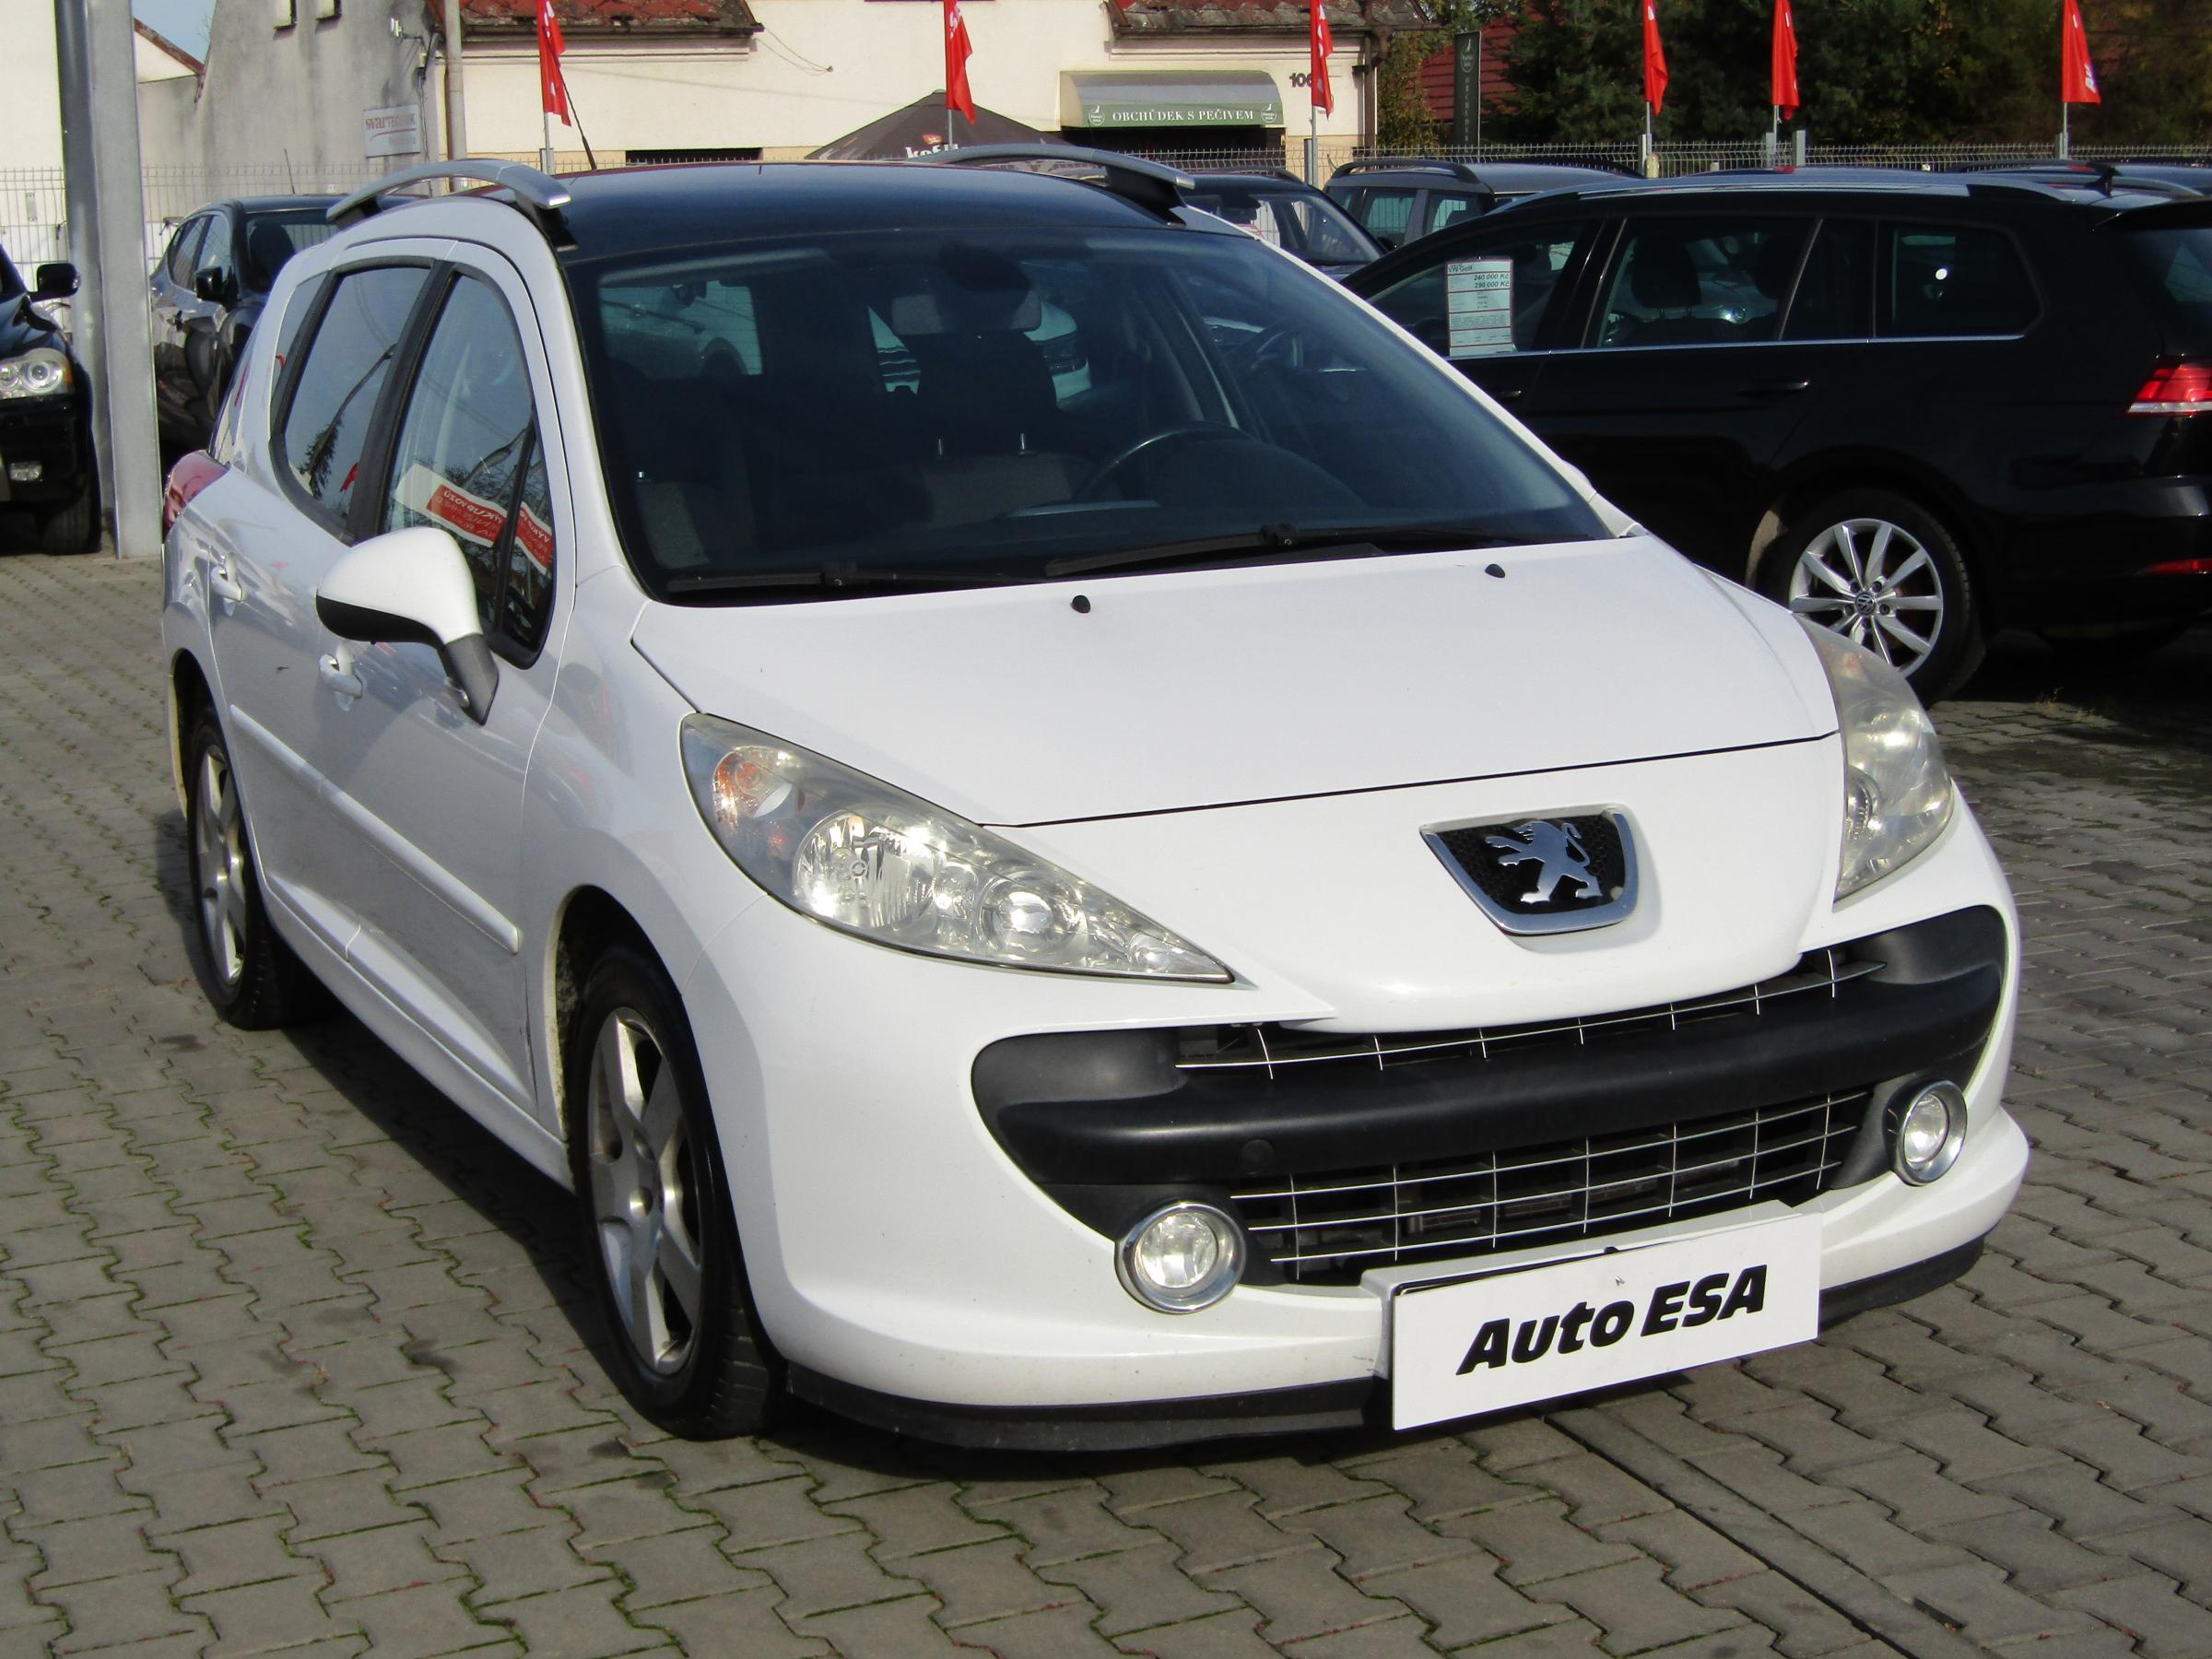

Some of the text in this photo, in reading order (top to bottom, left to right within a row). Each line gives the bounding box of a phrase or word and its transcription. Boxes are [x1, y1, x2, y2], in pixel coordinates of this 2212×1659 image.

[1112, 109, 1183, 122] OBCHŮDEK
[1187, 111, 1194, 121] S
[1198, 108, 1253, 121] PEČIVEM
[1456, 1265, 1767, 1375] Auto ESA
